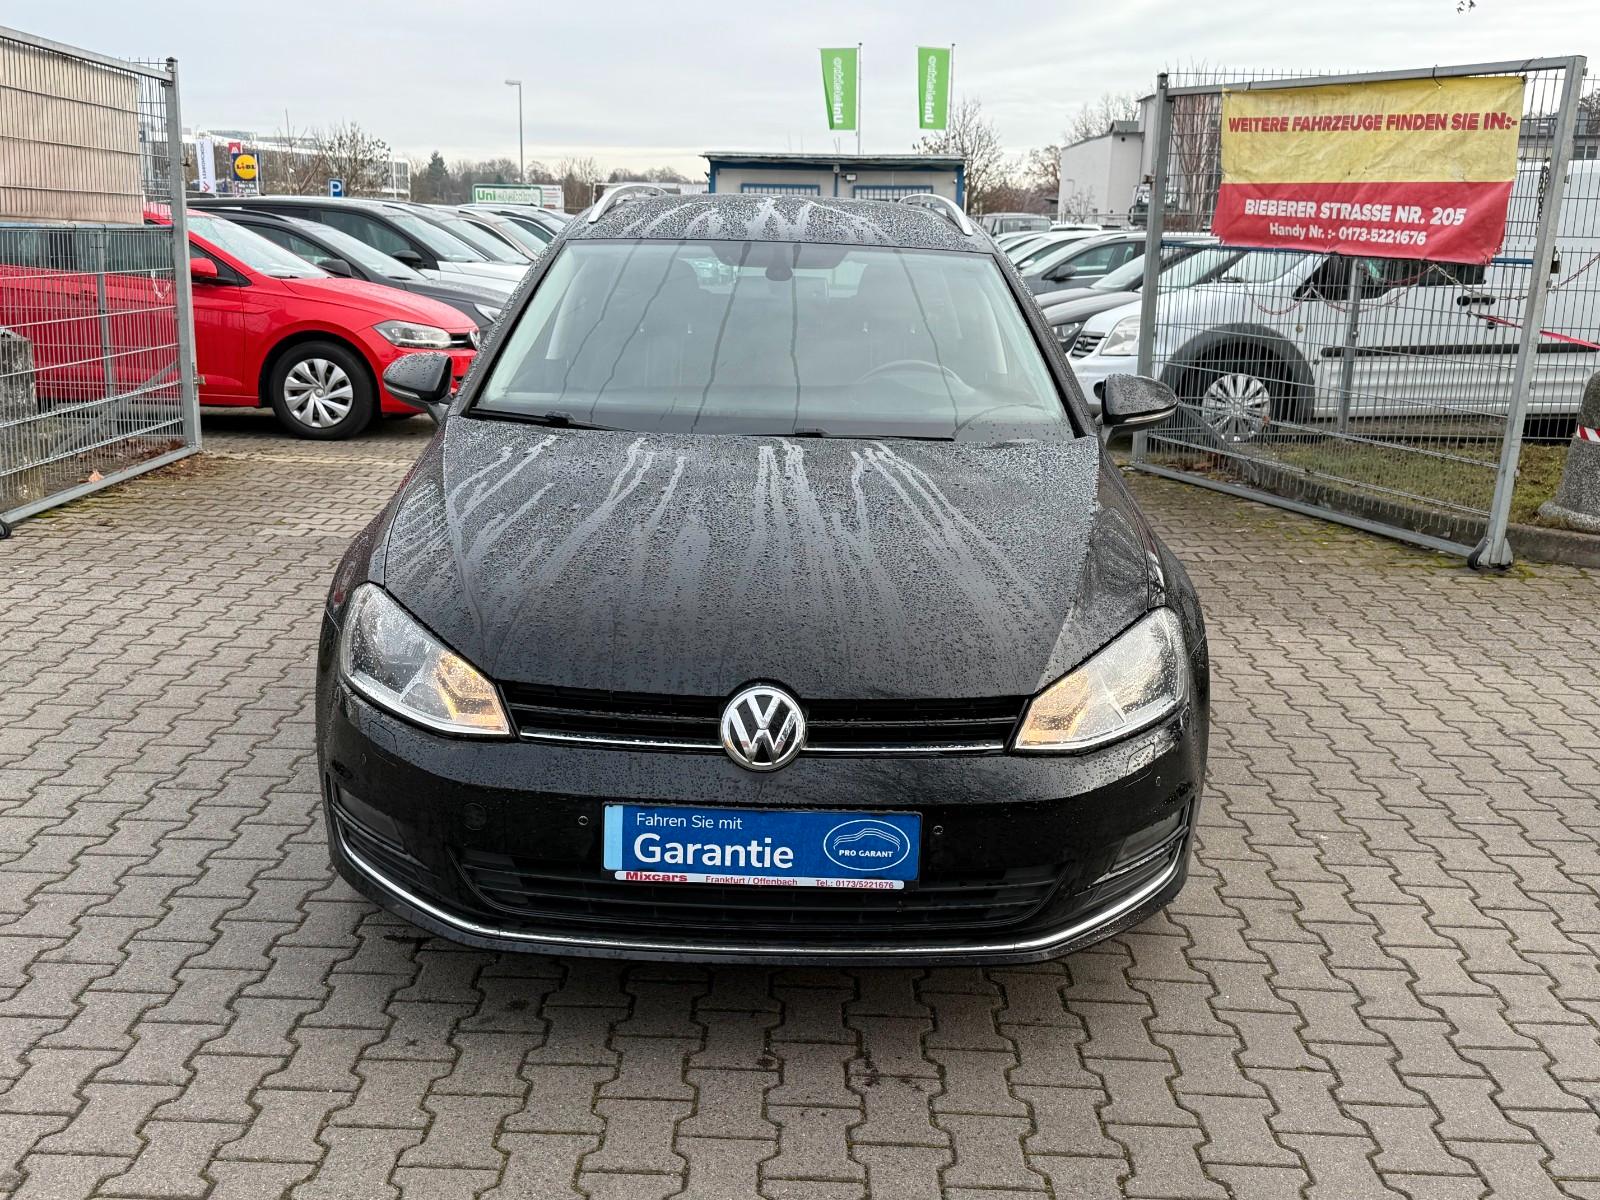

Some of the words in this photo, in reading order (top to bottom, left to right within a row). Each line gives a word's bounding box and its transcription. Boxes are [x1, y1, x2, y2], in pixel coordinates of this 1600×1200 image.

[1229, 117, 1290, 133] WEITERE
[1291, 114, 1383, 132] FAHRZEUGE
[1386, 113, 1448, 131] FINDEN
[1451, 113, 1480, 131] SIE
[330, 181, 341, 197] P
[1245, 199, 1317, 218] BIEBERER
[1319, 202, 1392, 222] STRASSE
[1394, 205, 1426, 224] NR.
[1429, 207, 1467, 226] 205
[1269, 222, 1306, 240] Handy
[1309, 224, 1325, 239] Nr.
[1338, 226, 1427, 246] 0173-5221676
[636, 812, 687, 828] Fahren
[691, 815, 714, 829] Sie
[719, 816, 743, 830] mit
[634, 832, 794, 869] Garantie
[858, 850, 894, 858] GARANT
[625, 871, 688, 882] Mixcars
[705, 875, 745, 884] Frankfurt
[752, 877, 798, 886] Offenbach
[816, 879, 833, 887] Tel.:
[835, 880, 894, 889] 0173/5221676
